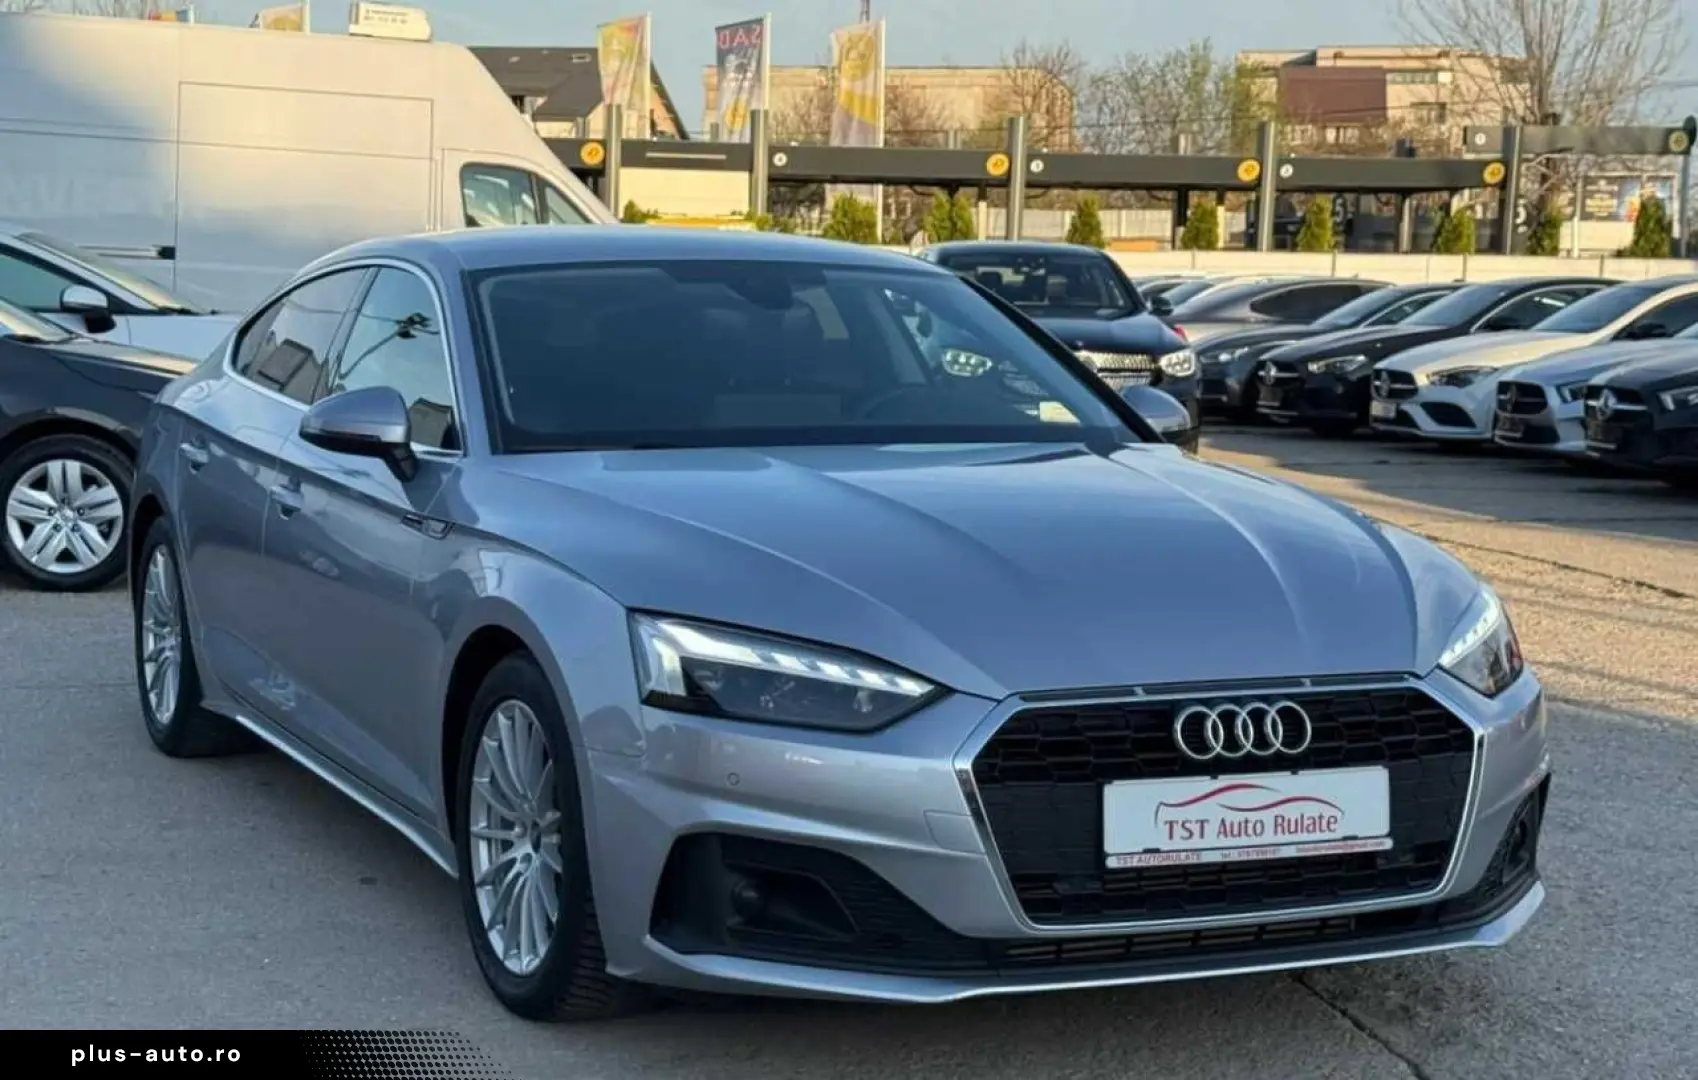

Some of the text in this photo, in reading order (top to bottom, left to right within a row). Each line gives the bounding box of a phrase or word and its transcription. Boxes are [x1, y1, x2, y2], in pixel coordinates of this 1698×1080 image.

[1164, 812, 1338, 841] TST Auto Rulate
[1117, 853, 1135, 866] TST
[1137, 850, 1202, 864] AUTORULATE
